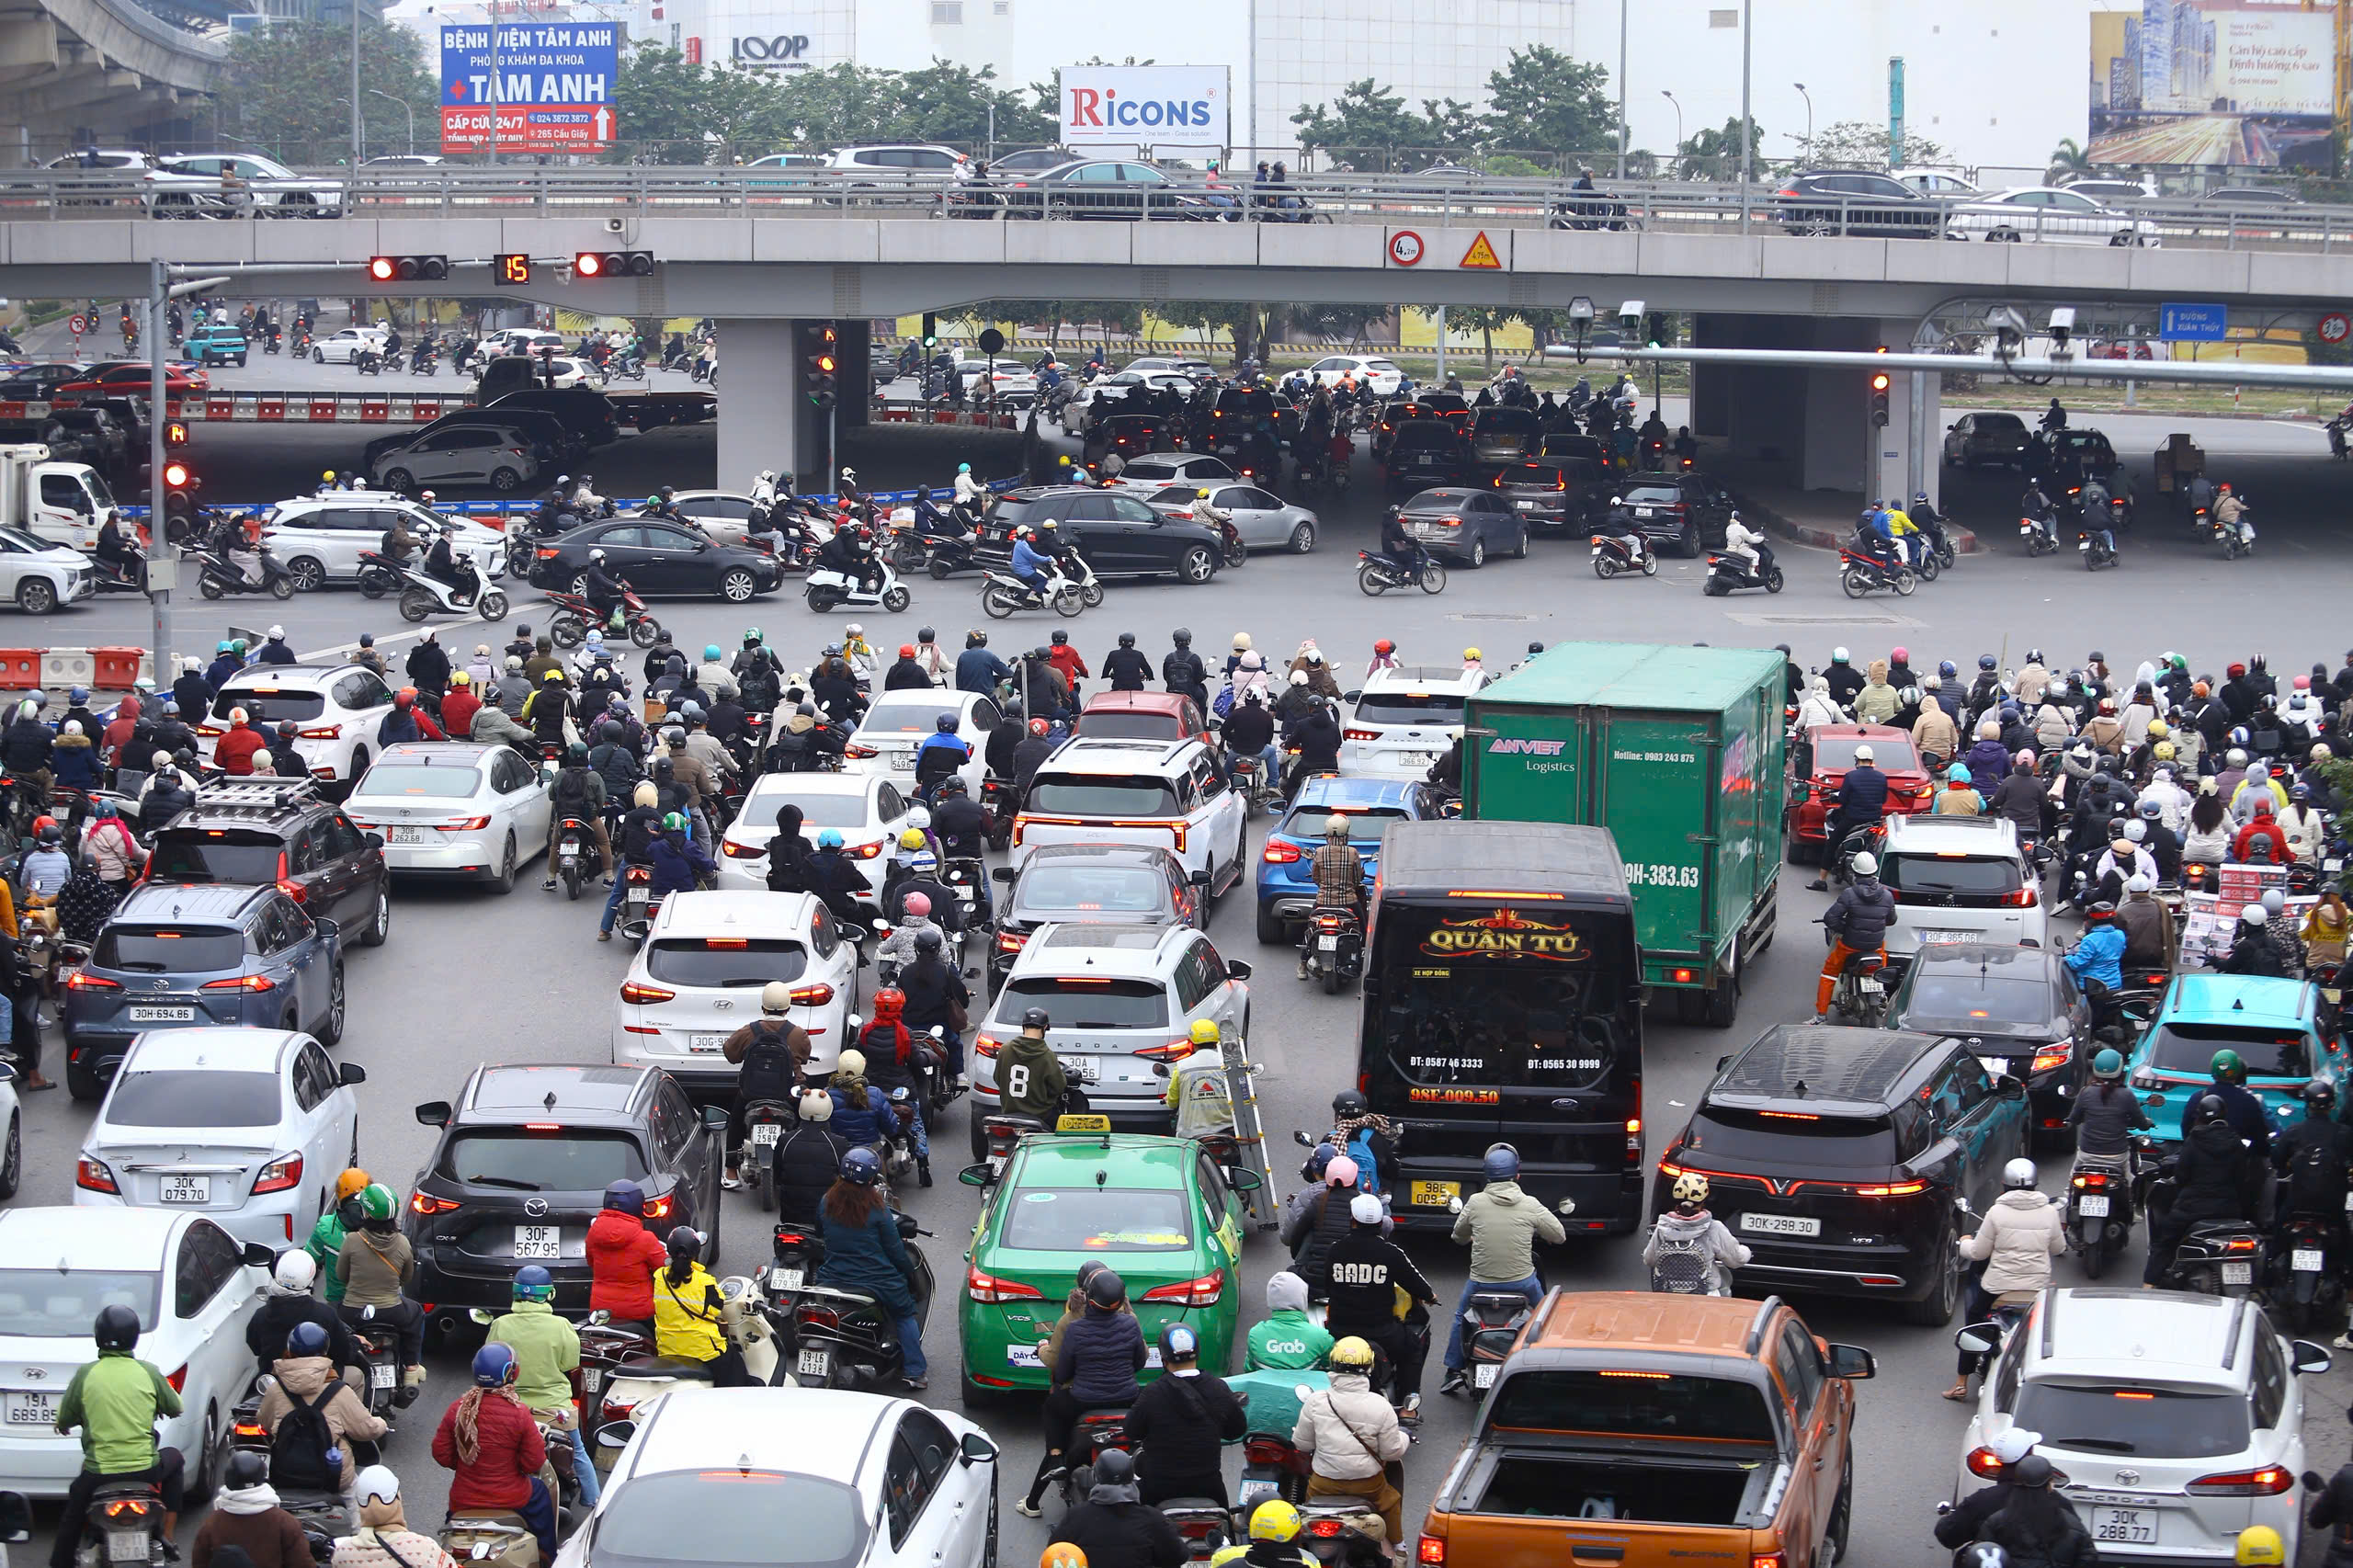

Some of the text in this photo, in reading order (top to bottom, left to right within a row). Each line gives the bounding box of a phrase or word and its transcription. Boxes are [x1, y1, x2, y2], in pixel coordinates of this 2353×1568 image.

[445, 29, 488, 53] BỆNH
[536, 27, 568, 47] TÂM
[575, 29, 611, 46] ANH
[733, 36, 809, 60] LOOP
[471, 52, 585, 66] PHÒG KHÁM ĐA KHOA
[469, 69, 605, 103] TÂM ANH
[447, 112, 470, 130] CẤP
[496, 117, 524, 130] 24/7
[537, 115, 588, 123] 024 3872 3872
[537, 130, 552, 139] 265
[571, 129, 589, 141] Giấy
[506, 256, 528, 281] 15
[1486, 739, 1567, 756] ANVIET
[1614, 750, 1696, 762] Hotline: 0903 243 875
[1527, 760, 1575, 774] Logistics
[1622, 862, 1699, 889] 9H-383.63
[1429, 928, 1580, 953] QUÂN TỨ
[135, 1007, 189, 1019] 30H-694.86
[1068, 1057, 1088, 1067] 30A
[1410, 1056, 1424, 1067] ĐT:
[1426, 1057, 1447, 1067] 0587
[1461, 1059, 1483, 1068] 3333
[1528, 1059, 1600, 1069] ĐT: 0565 30 9999
[1009, 1063, 1030, 1098] 8
[1410, 1087, 1498, 1104] 98E-009.50
[756, 1125, 778, 1133] 37-U2
[176, 1178, 195, 1188] 30K
[1426, 1183, 1447, 1193] 98E
[166, 1189, 205, 1200] 079.70
[1416, 1194, 1453, 1205] 009.5
[1748, 1218, 1813, 1233] 30K-298.30
[526, 1227, 549, 1241] 30F
[516, 1242, 559, 1256] 567.95
[776, 1270, 799, 1279] 36-B7
[772, 1279, 800, 1290] 679.36
[1266, 1338, 1306, 1354] Grab
[803, 1352, 824, 1364] 19-L6
[1013, 1351, 1029, 1360] DÂY
[801, 1363, 823, 1374] 4138
[24, 1394, 48, 1407] 19A
[2111, 1509, 2139, 1525] 30K
[2098, 1525, 2150, 1541] 288.77
